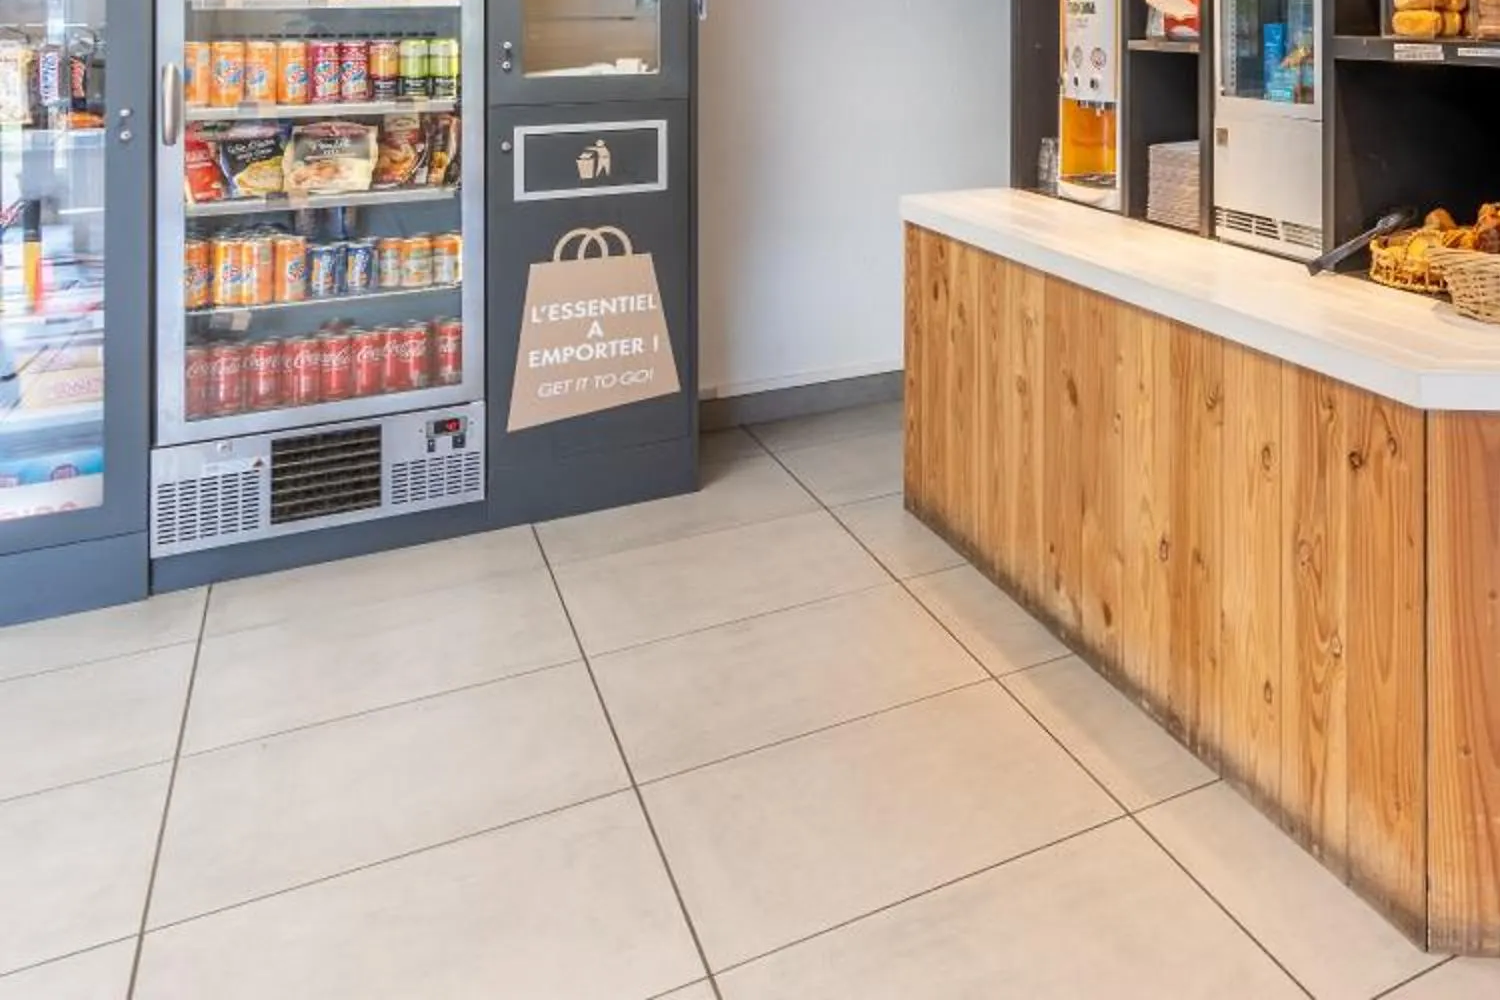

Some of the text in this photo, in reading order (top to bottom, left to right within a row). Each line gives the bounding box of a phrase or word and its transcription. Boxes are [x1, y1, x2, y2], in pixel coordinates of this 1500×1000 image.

[531, 293, 657, 323] L'ESSENTIEL
[528, 337, 644, 368] EMPORTER
[537, 379, 572, 398] GET
[575, 377, 589, 392] IT
[594, 373, 617, 389] TO
